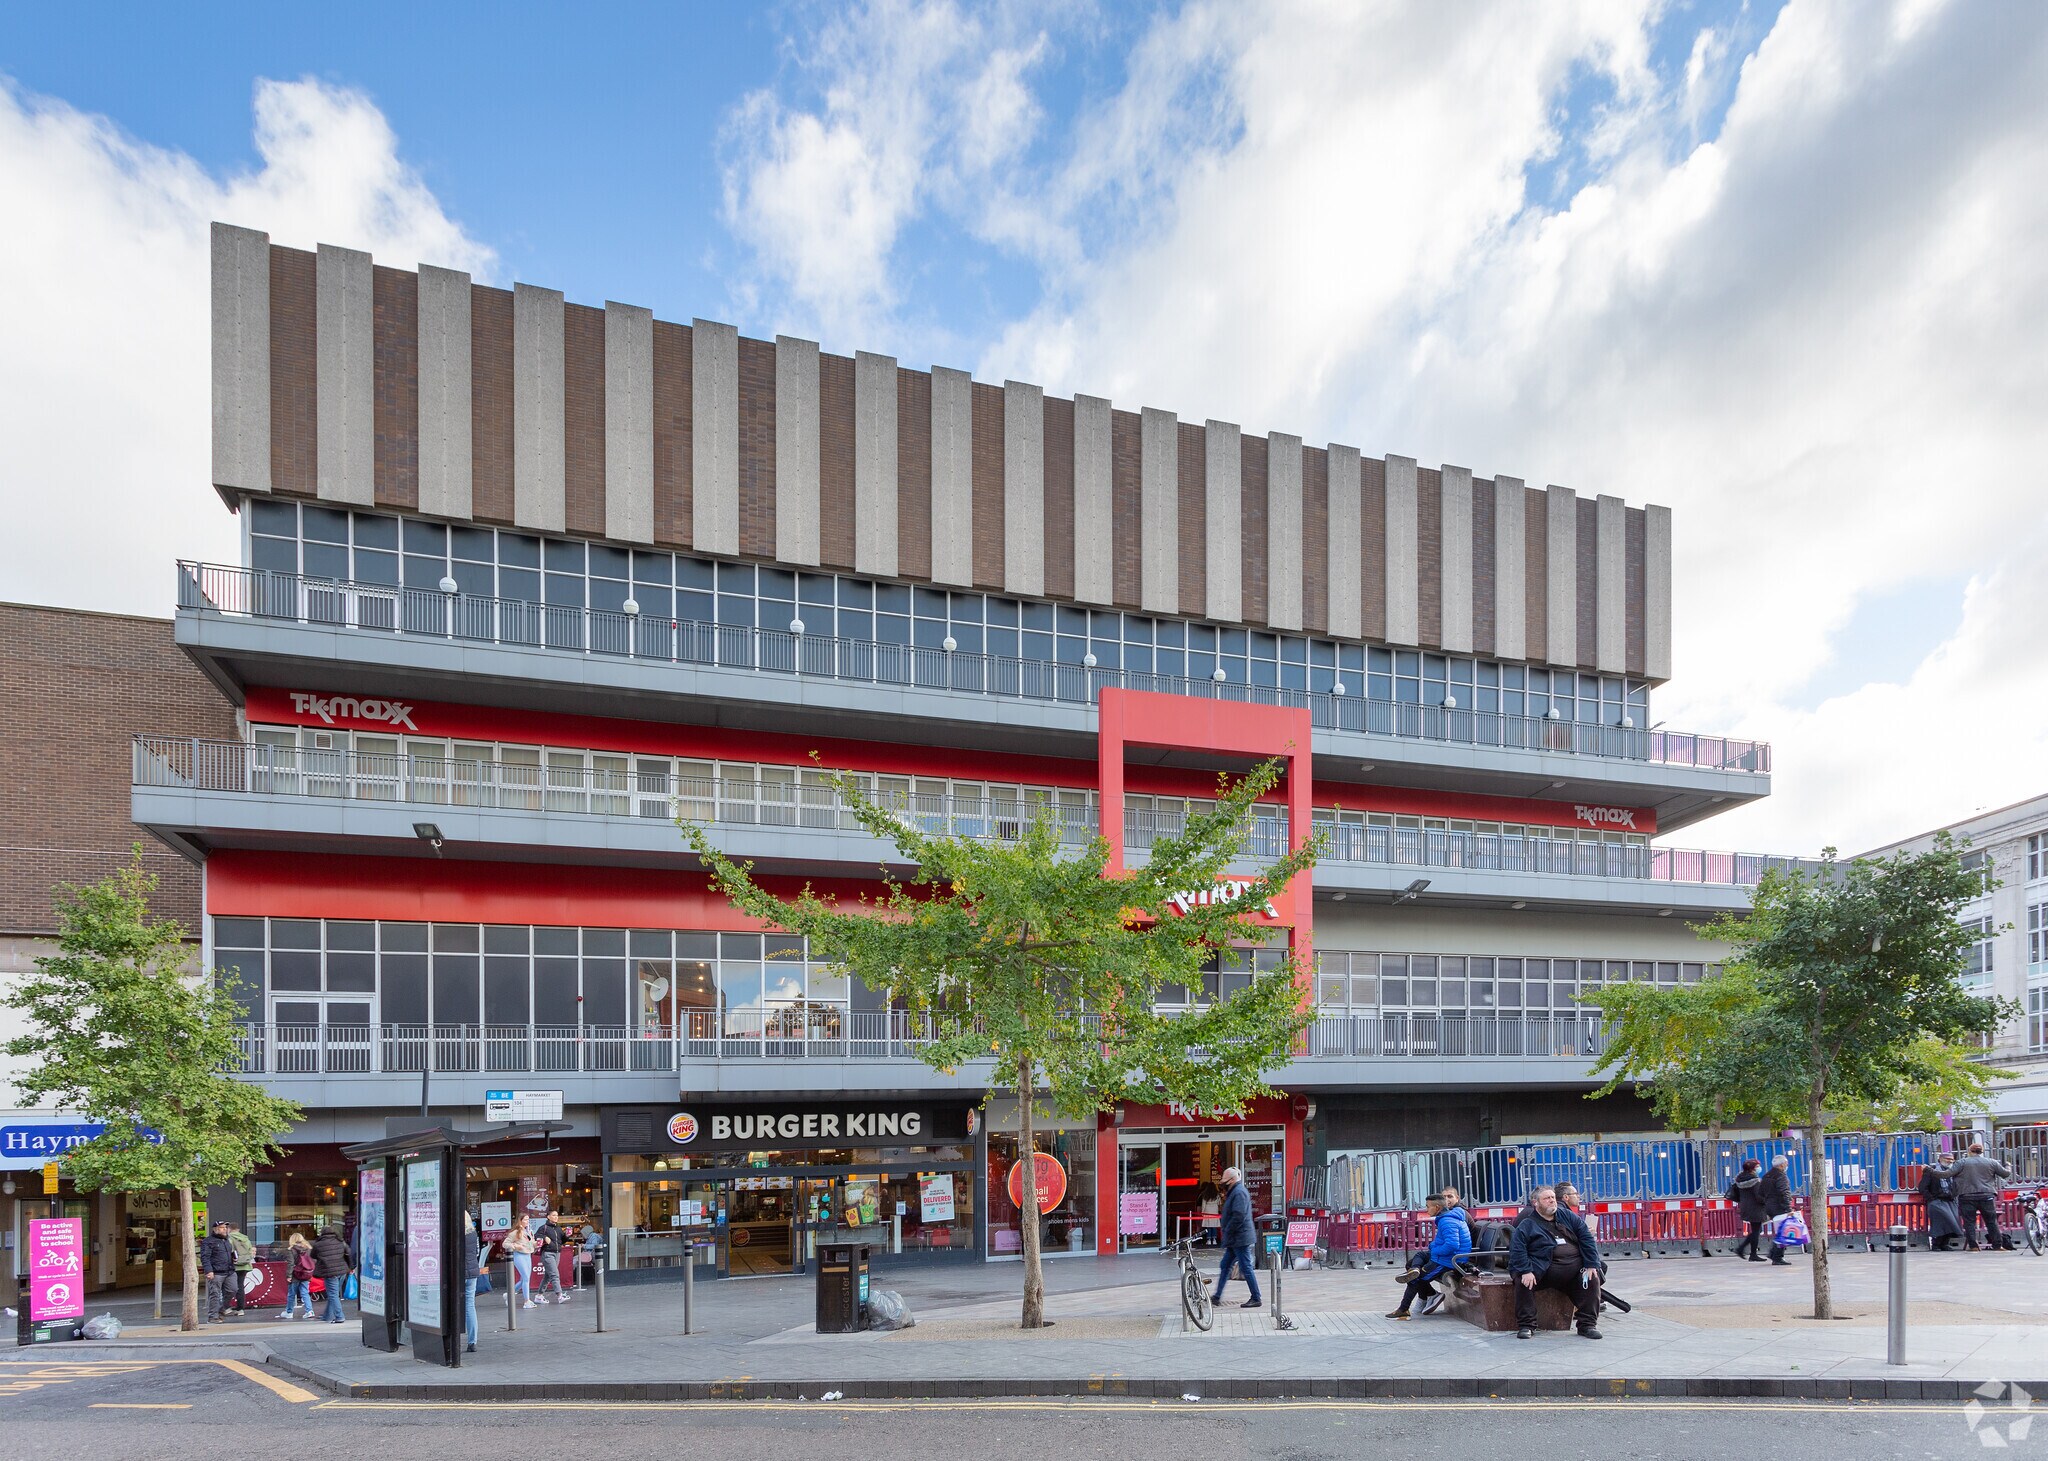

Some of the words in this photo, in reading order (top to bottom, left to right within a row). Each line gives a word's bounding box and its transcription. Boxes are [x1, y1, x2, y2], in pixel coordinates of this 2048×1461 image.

[672, 1120, 694, 1128] BURGER
[672, 1125, 694, 1135] KING
[712, 1114, 840, 1139] BURGER
[846, 1112, 921, 1137] KING
[1036, 1159, 1049, 1174] ig
